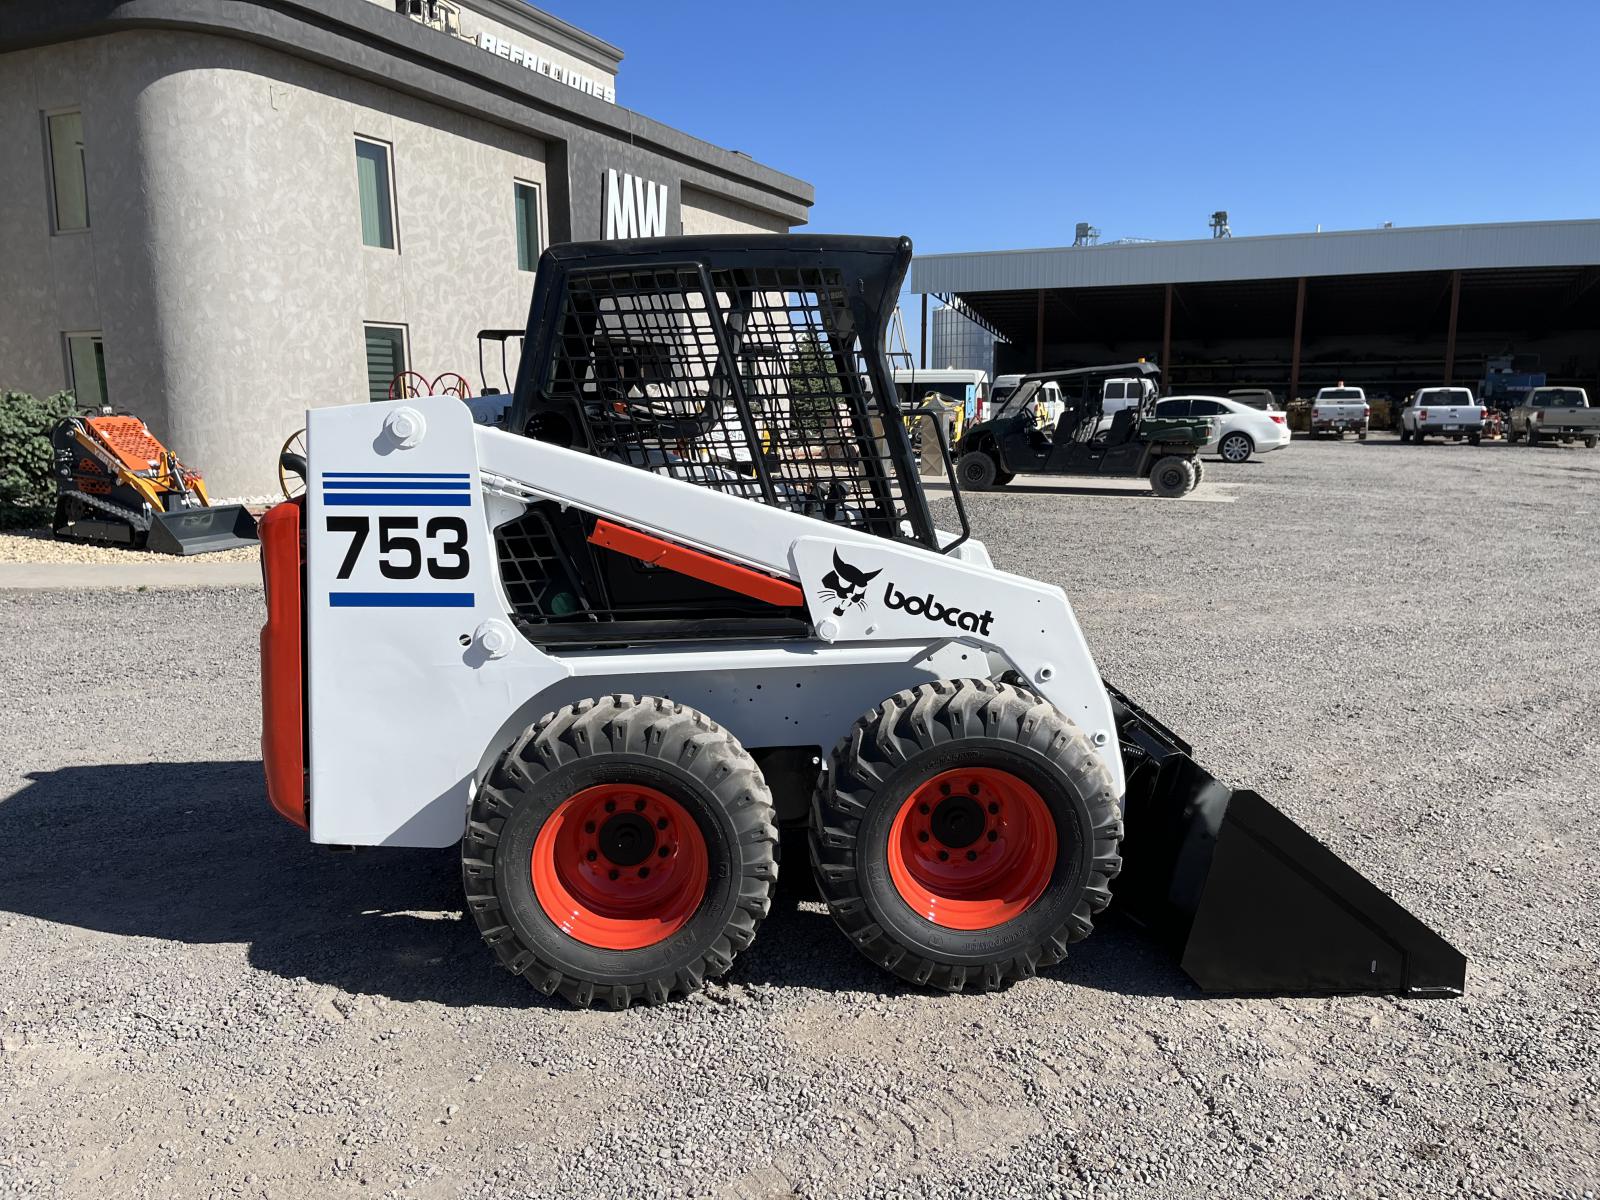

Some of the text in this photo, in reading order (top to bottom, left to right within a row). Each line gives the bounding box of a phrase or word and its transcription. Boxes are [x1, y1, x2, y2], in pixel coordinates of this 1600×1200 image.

[480, 32, 616, 104] REFACCIONES
[606, 168, 668, 240] MW
[326, 516, 470, 579] 753
[883, 582, 994, 636] bobcat
